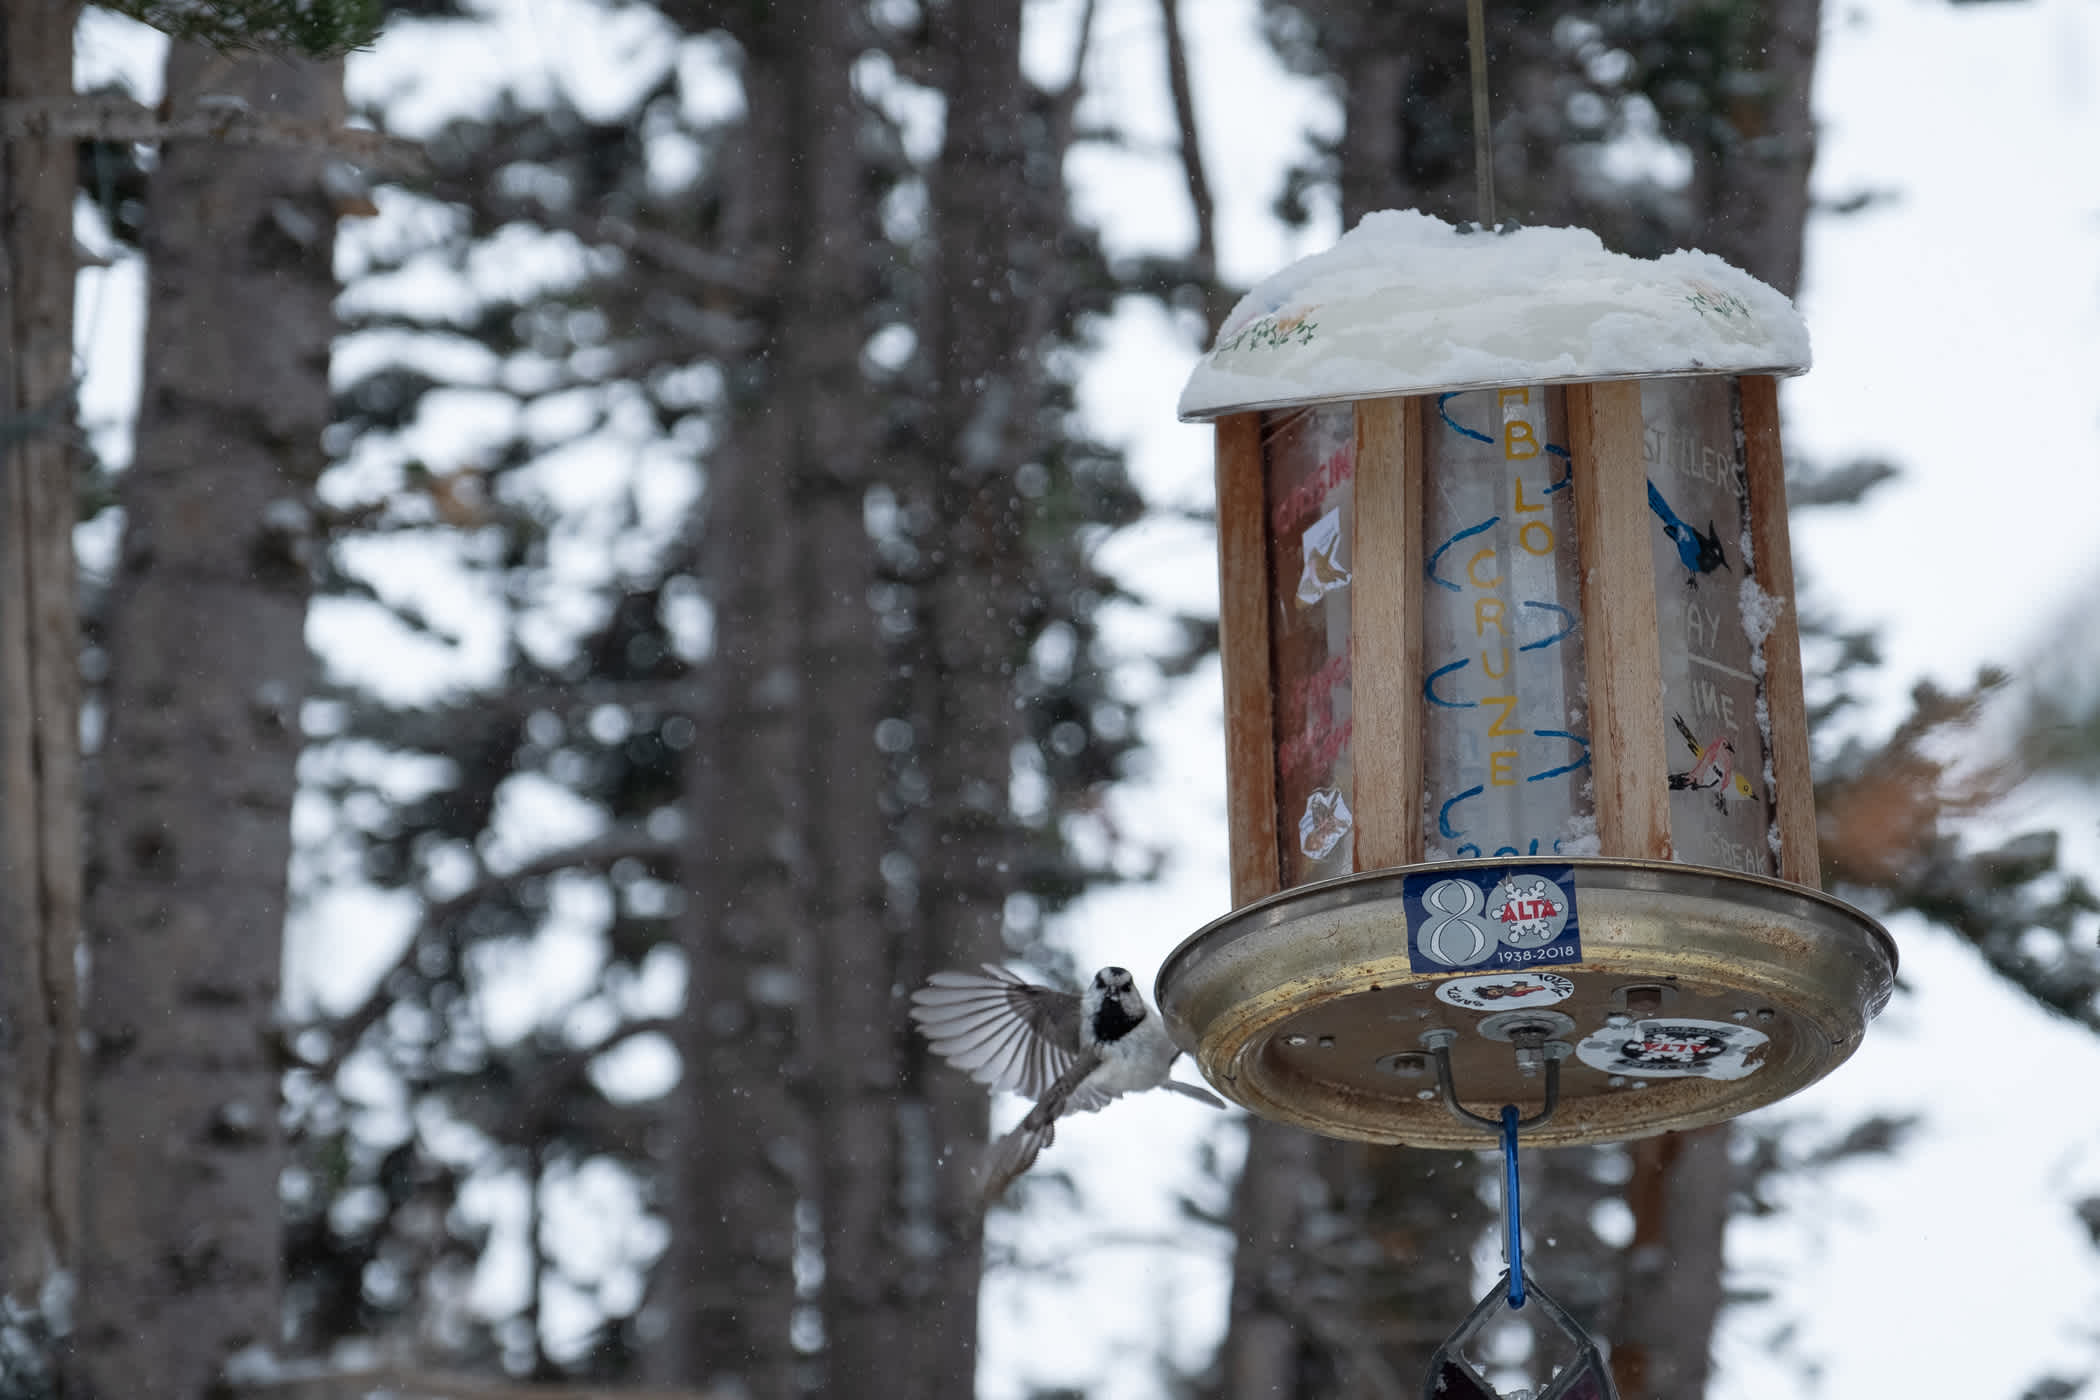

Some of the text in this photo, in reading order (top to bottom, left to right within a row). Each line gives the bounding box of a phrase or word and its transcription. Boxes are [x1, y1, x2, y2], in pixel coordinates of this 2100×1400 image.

[1466, 548, 1525, 787] CRUZE
[1501, 899, 1557, 923] ALTA
[1498, 946, 1575, 962] 1938-2018
[1642, 1042, 1708, 1054] ALTA
